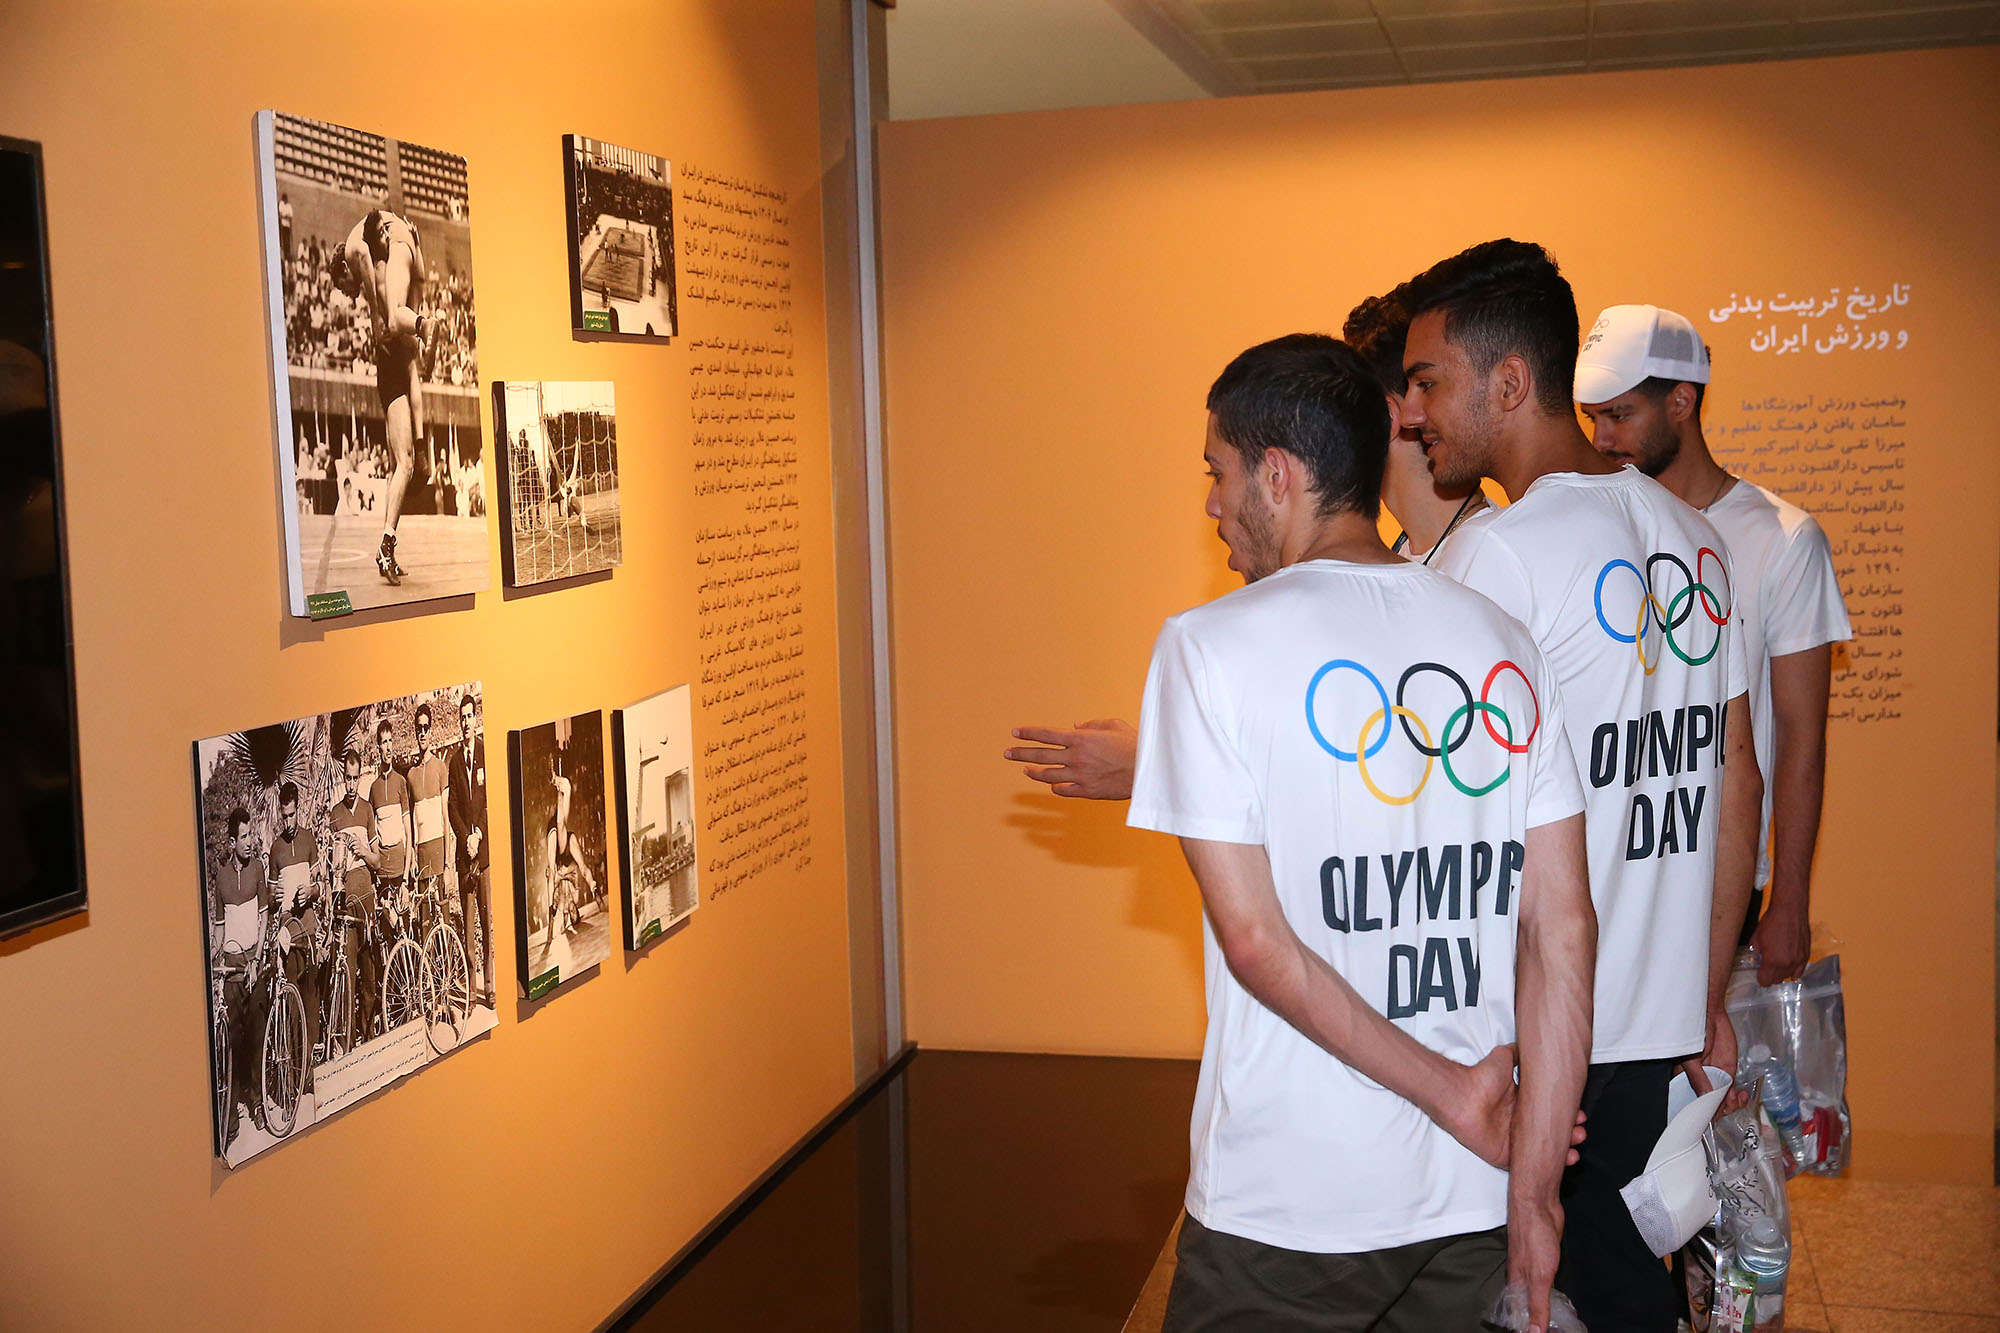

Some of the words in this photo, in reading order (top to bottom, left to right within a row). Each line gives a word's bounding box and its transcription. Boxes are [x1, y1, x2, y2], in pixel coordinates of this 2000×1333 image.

[1709, 293, 1763, 322] بدنی
[1769, 288, 1840, 317] تربیت
[1846, 283, 1910, 319] تاریخ
[1750, 323, 1808, 355] ایران
[1815, 324, 1889, 353] ورزش
[1896, 330, 1908, 348] و
[1818, 397, 1855, 412] ورزش
[1768, 419, 1817, 433] فرهنگ
[1862, 415, 1905, 430] سامان
[1876, 437, 1905, 453] میرزا
[1753, 461, 1777, 474] سال
[1879, 479, 1904, 492] سال
[1852, 543, 1888, 557] دنبال
[1859, 584, 1903, 598] سازمان
[1871, 604, 1902, 619] قانون
[1851, 646, 1882, 658] سال
[1862, 667, 1902, 681] شورای
[1857, 707, 1901, 722] مدارس
[1626, 786, 1706, 861] DAY
[1388, 937, 1480, 1019] DAY
